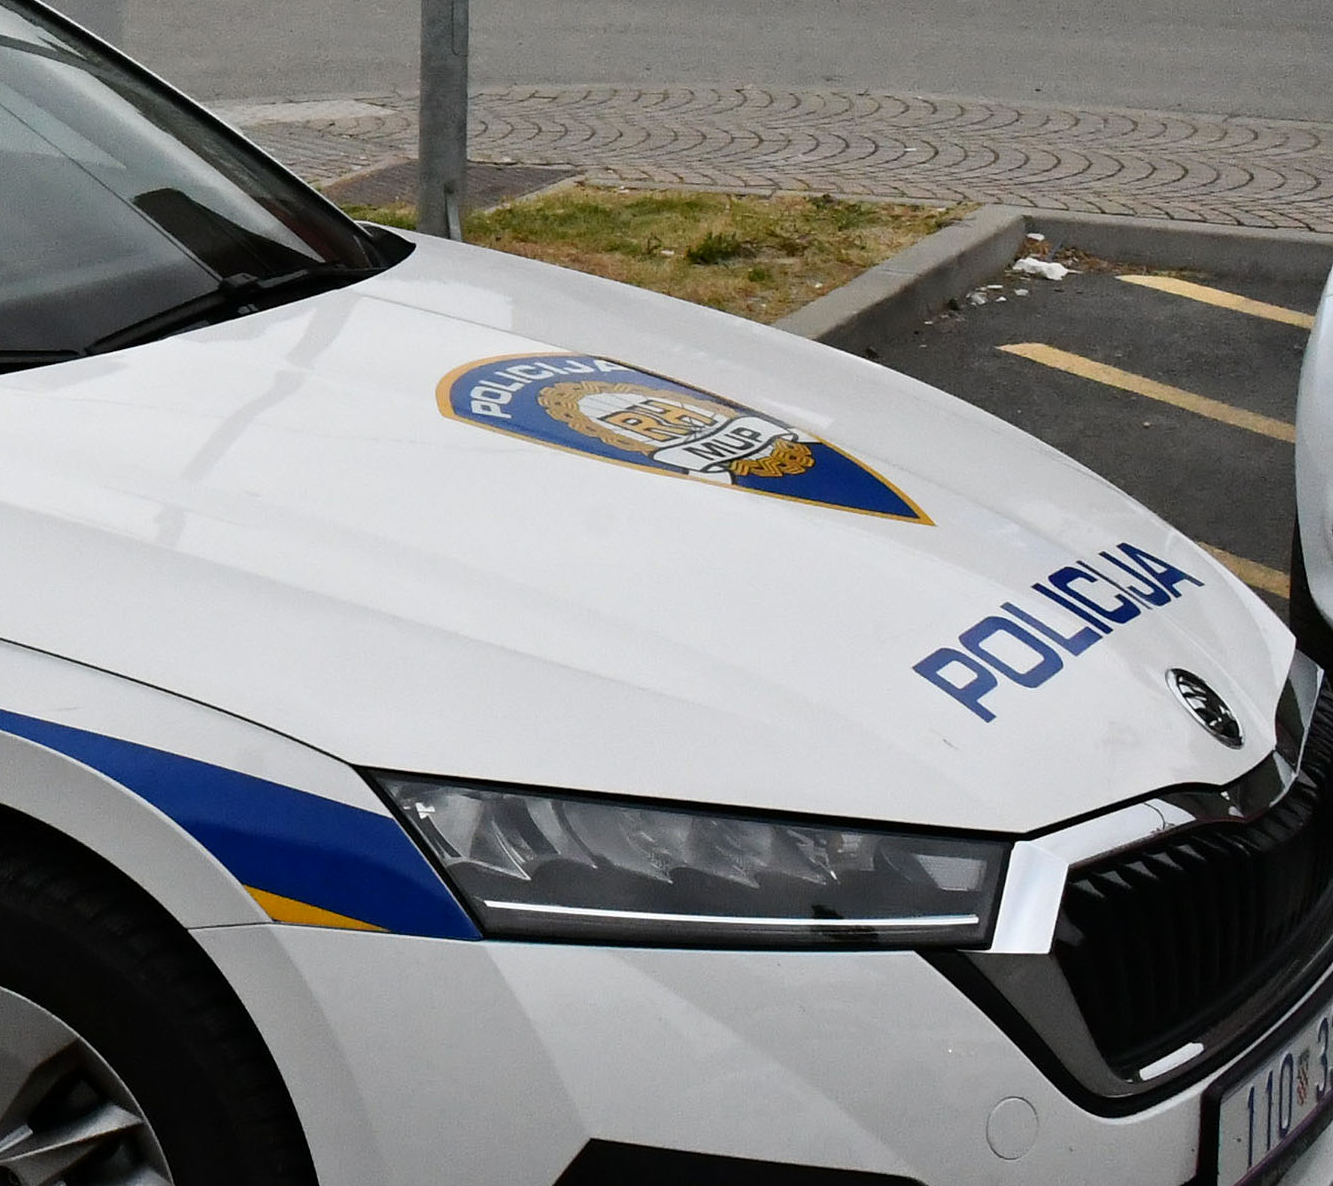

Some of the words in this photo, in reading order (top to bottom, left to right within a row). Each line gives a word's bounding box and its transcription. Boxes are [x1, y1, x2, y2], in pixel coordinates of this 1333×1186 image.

[469, 357, 633, 419] POLICIJA
[598, 398, 721, 442] RH
[687, 425, 763, 465] MUP
[912, 542, 1205, 724] POLICIJA
[1247, 1052, 1294, 1169] 110
